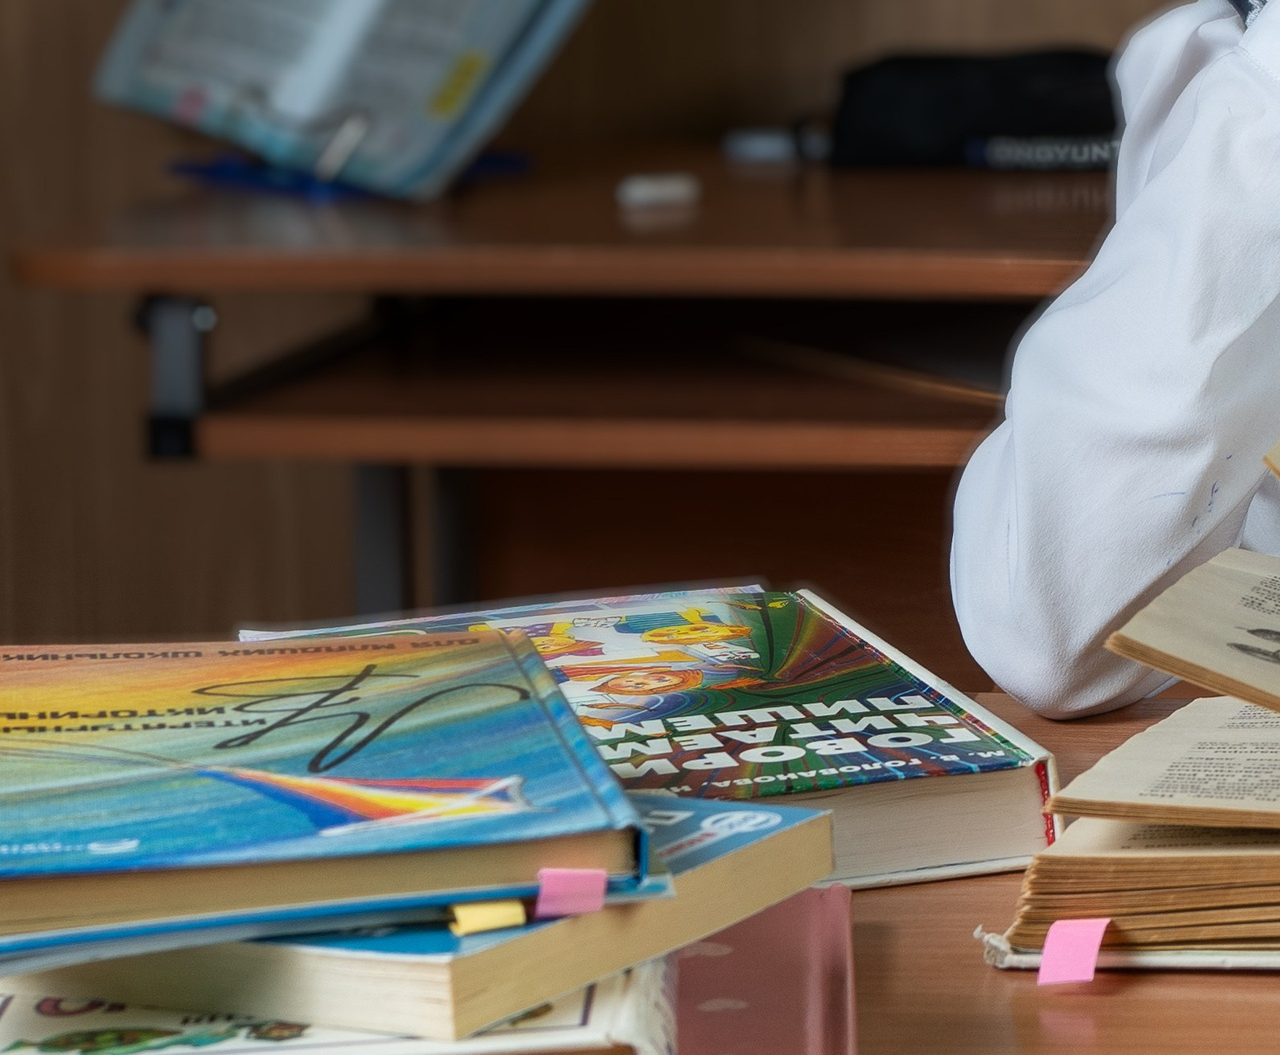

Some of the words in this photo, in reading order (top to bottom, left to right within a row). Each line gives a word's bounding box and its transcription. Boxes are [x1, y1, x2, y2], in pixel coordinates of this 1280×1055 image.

[218, 642, 396, 657] МЛАДШИХ
[411, 637, 481, 649] ДЛЯ
[588, 695, 935, 741] ПИШЕМ
[601, 712, 960, 760] ЧИТАЕМ
[930, 753, 959, 763] В.
[967, 749, 1006, 759] М.
[702, 757, 923, 789] ГОЛОВАНОВА,
